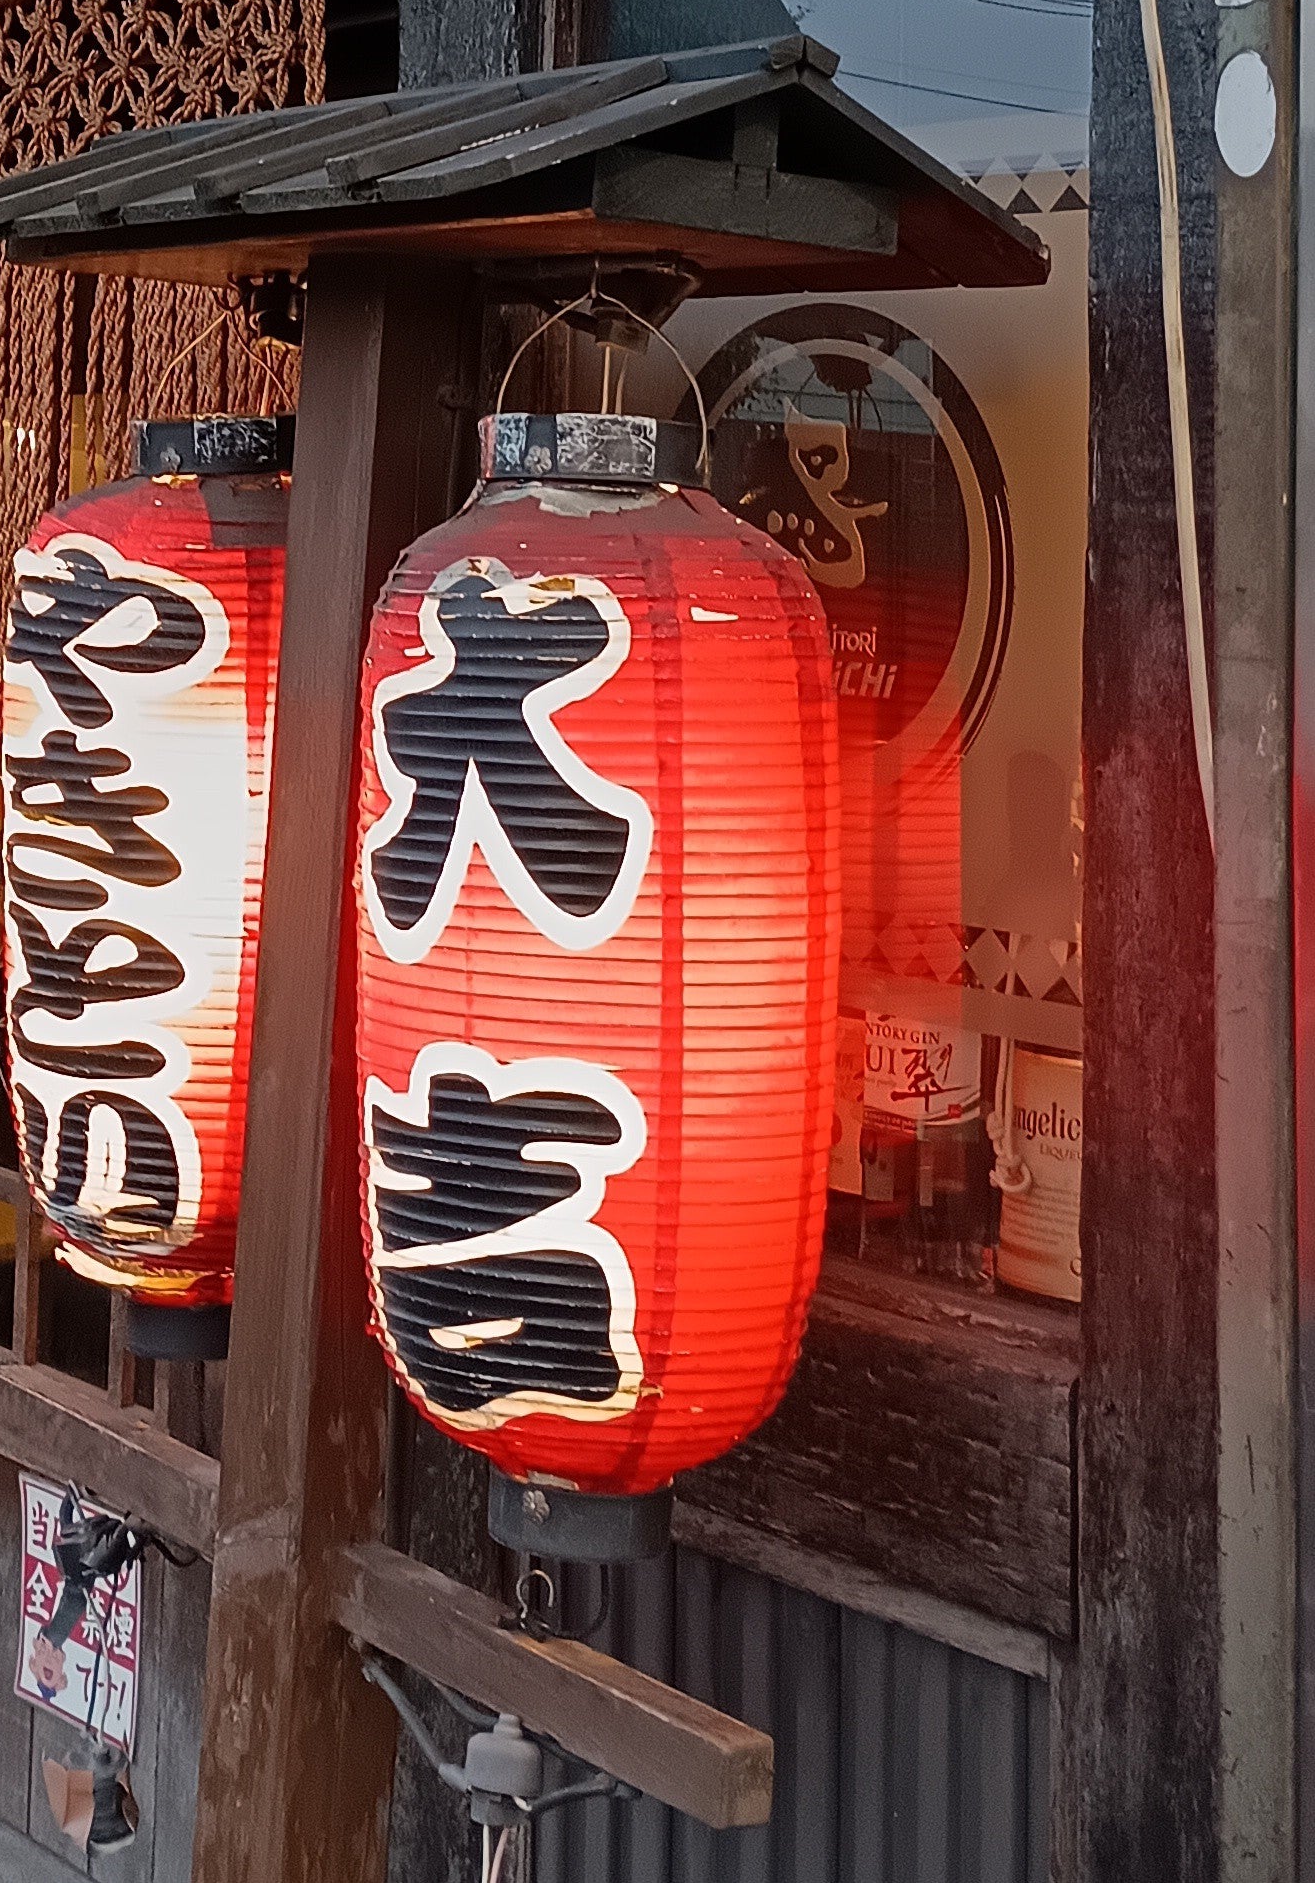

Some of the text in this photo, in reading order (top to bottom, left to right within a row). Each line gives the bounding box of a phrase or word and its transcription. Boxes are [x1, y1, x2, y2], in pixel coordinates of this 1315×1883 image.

[3, 540, 214, 1236] やきとり
[364, 563, 646, 1423] 大吉
[865, 1022, 941, 1045] NTORY GIN
[865, 1044, 897, 1076] UI
[1013, 1102, 1081, 1142] ngelic
[1040, 1142, 1082, 1162] LIQUE
[26, 1561, 134, 1660] 全禁煙
